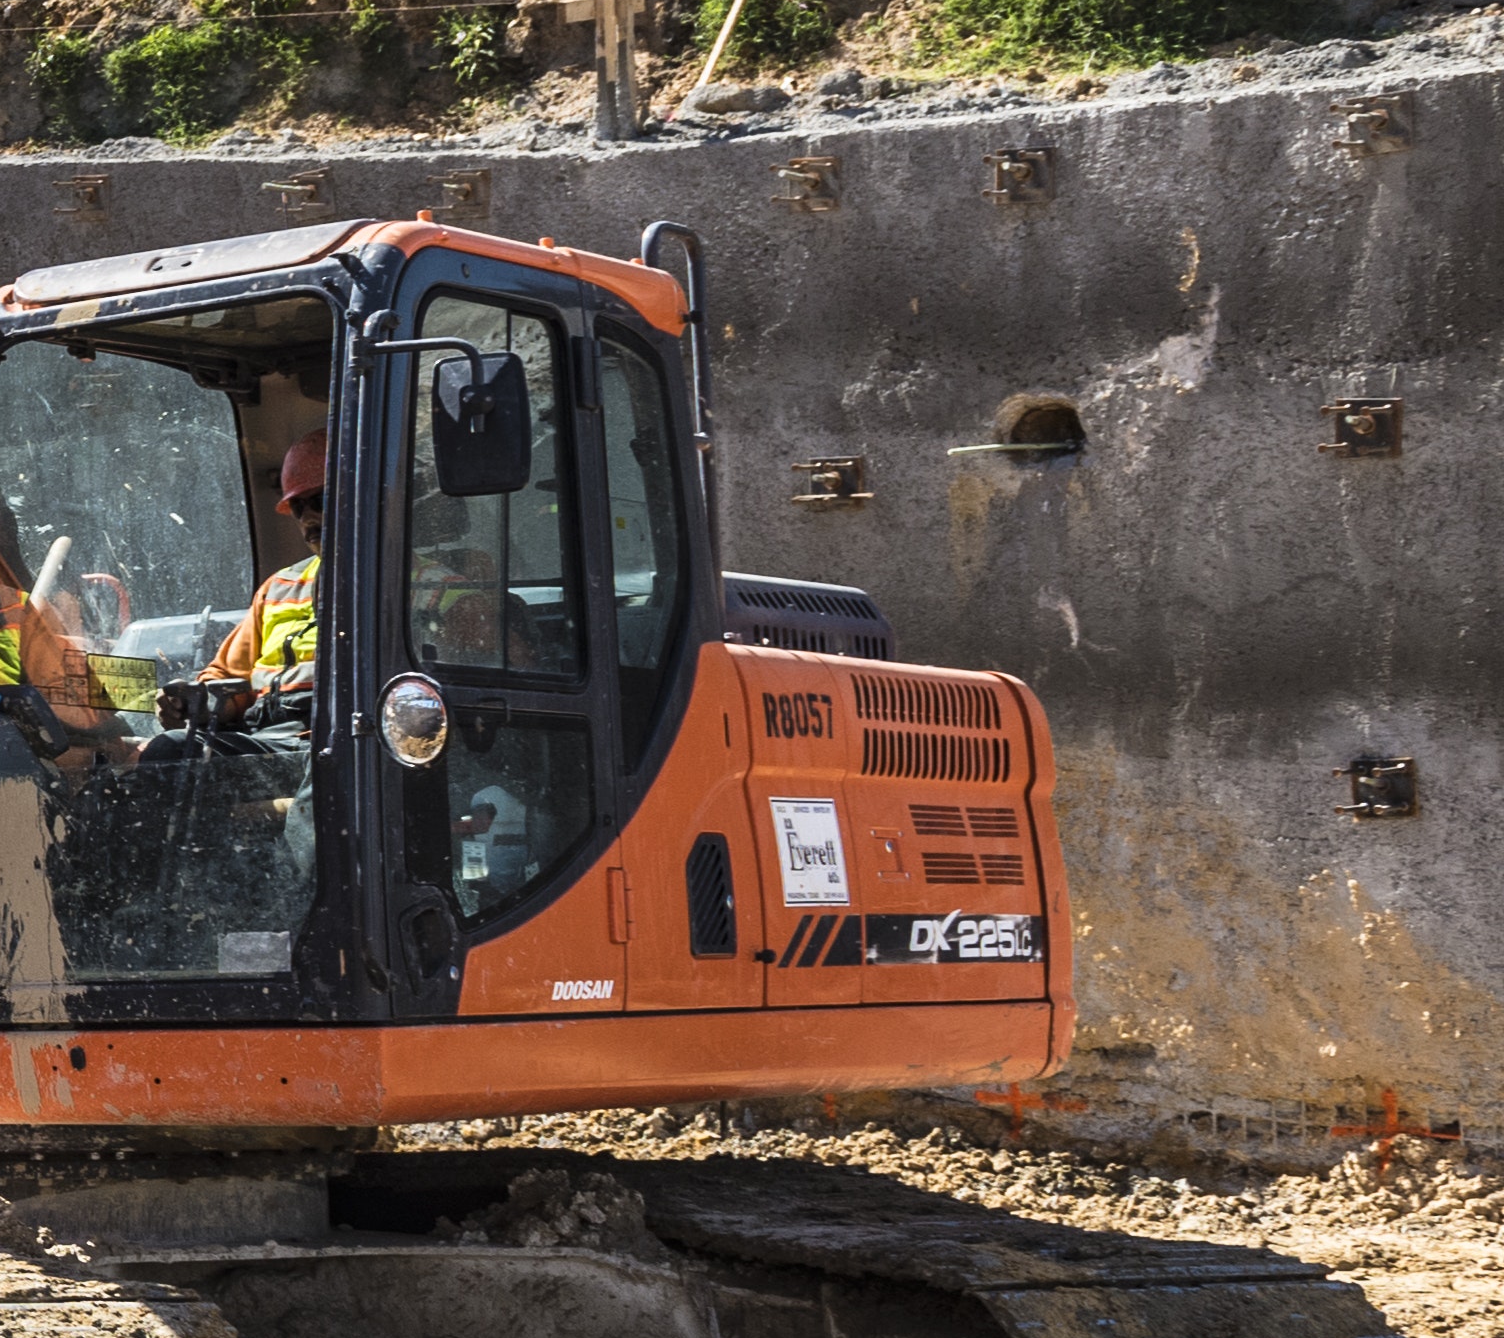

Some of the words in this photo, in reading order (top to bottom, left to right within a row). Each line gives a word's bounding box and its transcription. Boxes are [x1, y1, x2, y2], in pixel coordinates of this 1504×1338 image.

[762, 693, 833, 739] R8057
[786, 831, 837, 871] Everett
[551, 980, 615, 1001] DOOSAN
